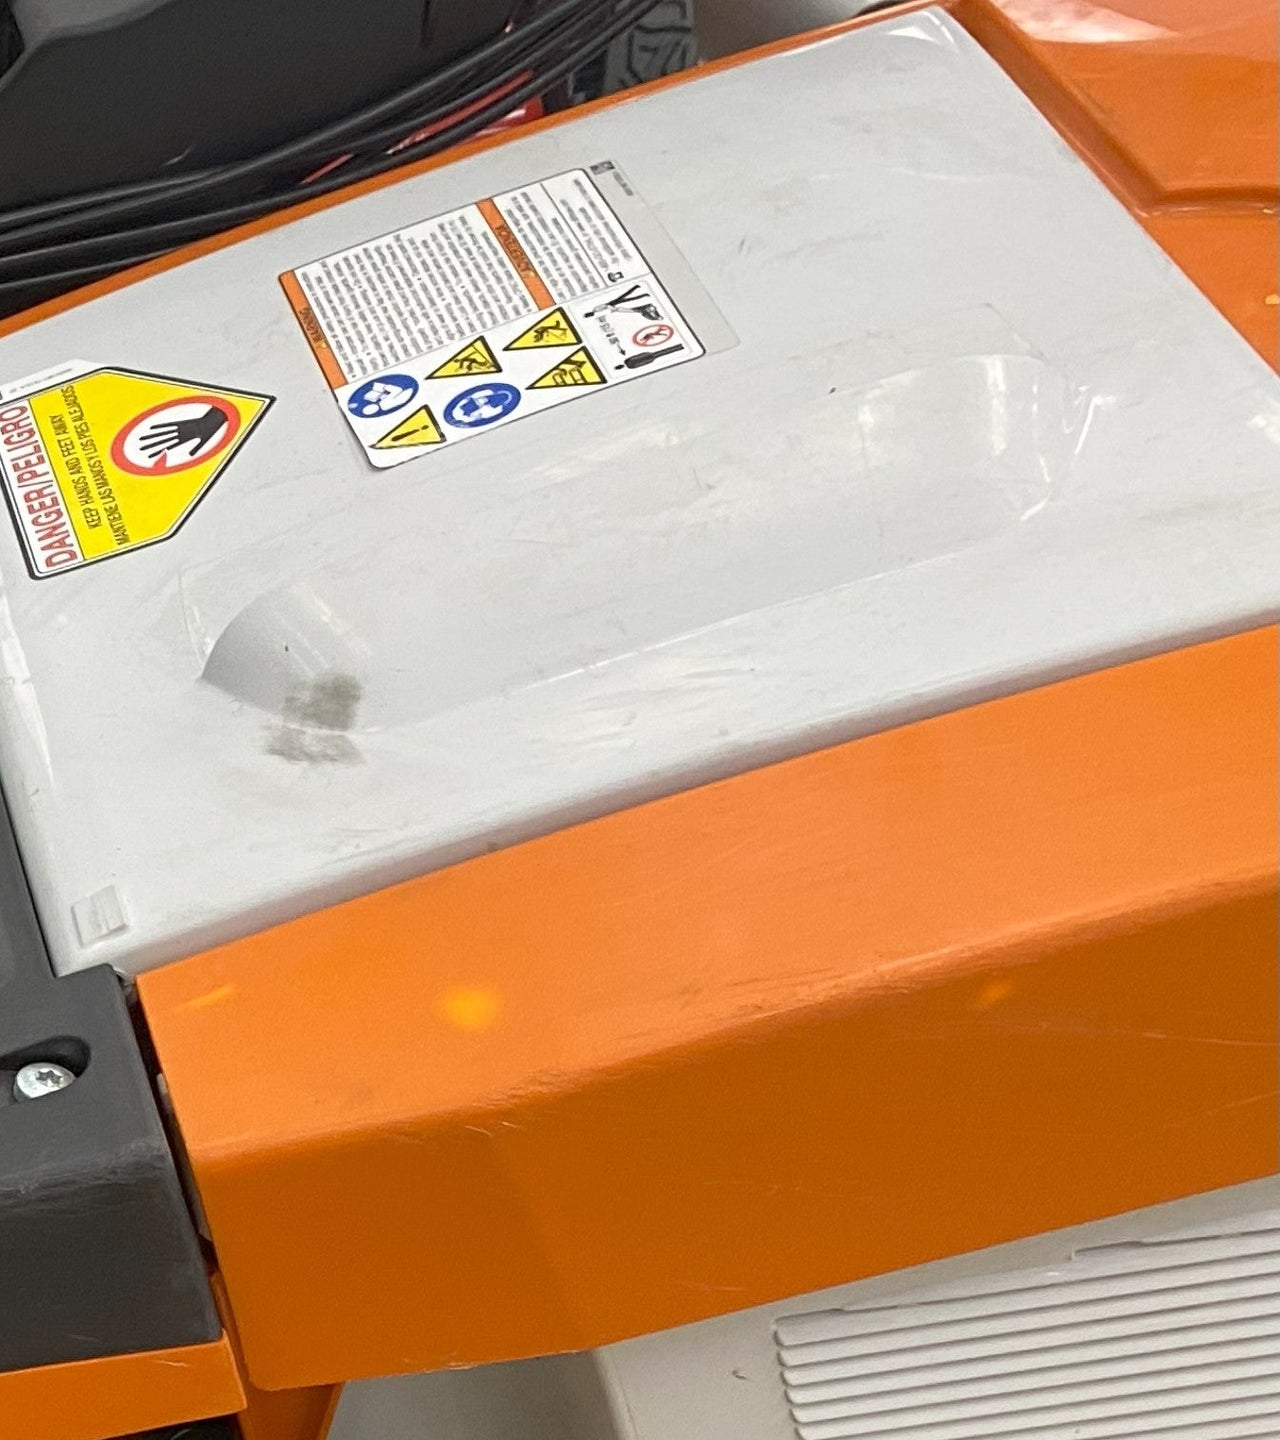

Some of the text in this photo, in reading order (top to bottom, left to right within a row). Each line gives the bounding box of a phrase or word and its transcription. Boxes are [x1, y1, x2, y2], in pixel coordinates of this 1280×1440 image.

[80, 439, 97, 455] LOS
[49, 414, 102, 529] KEEP HANDS AND FEET AWAY
[88, 459, 110, 489] MANOS
[98, 488, 116, 505] LAS
